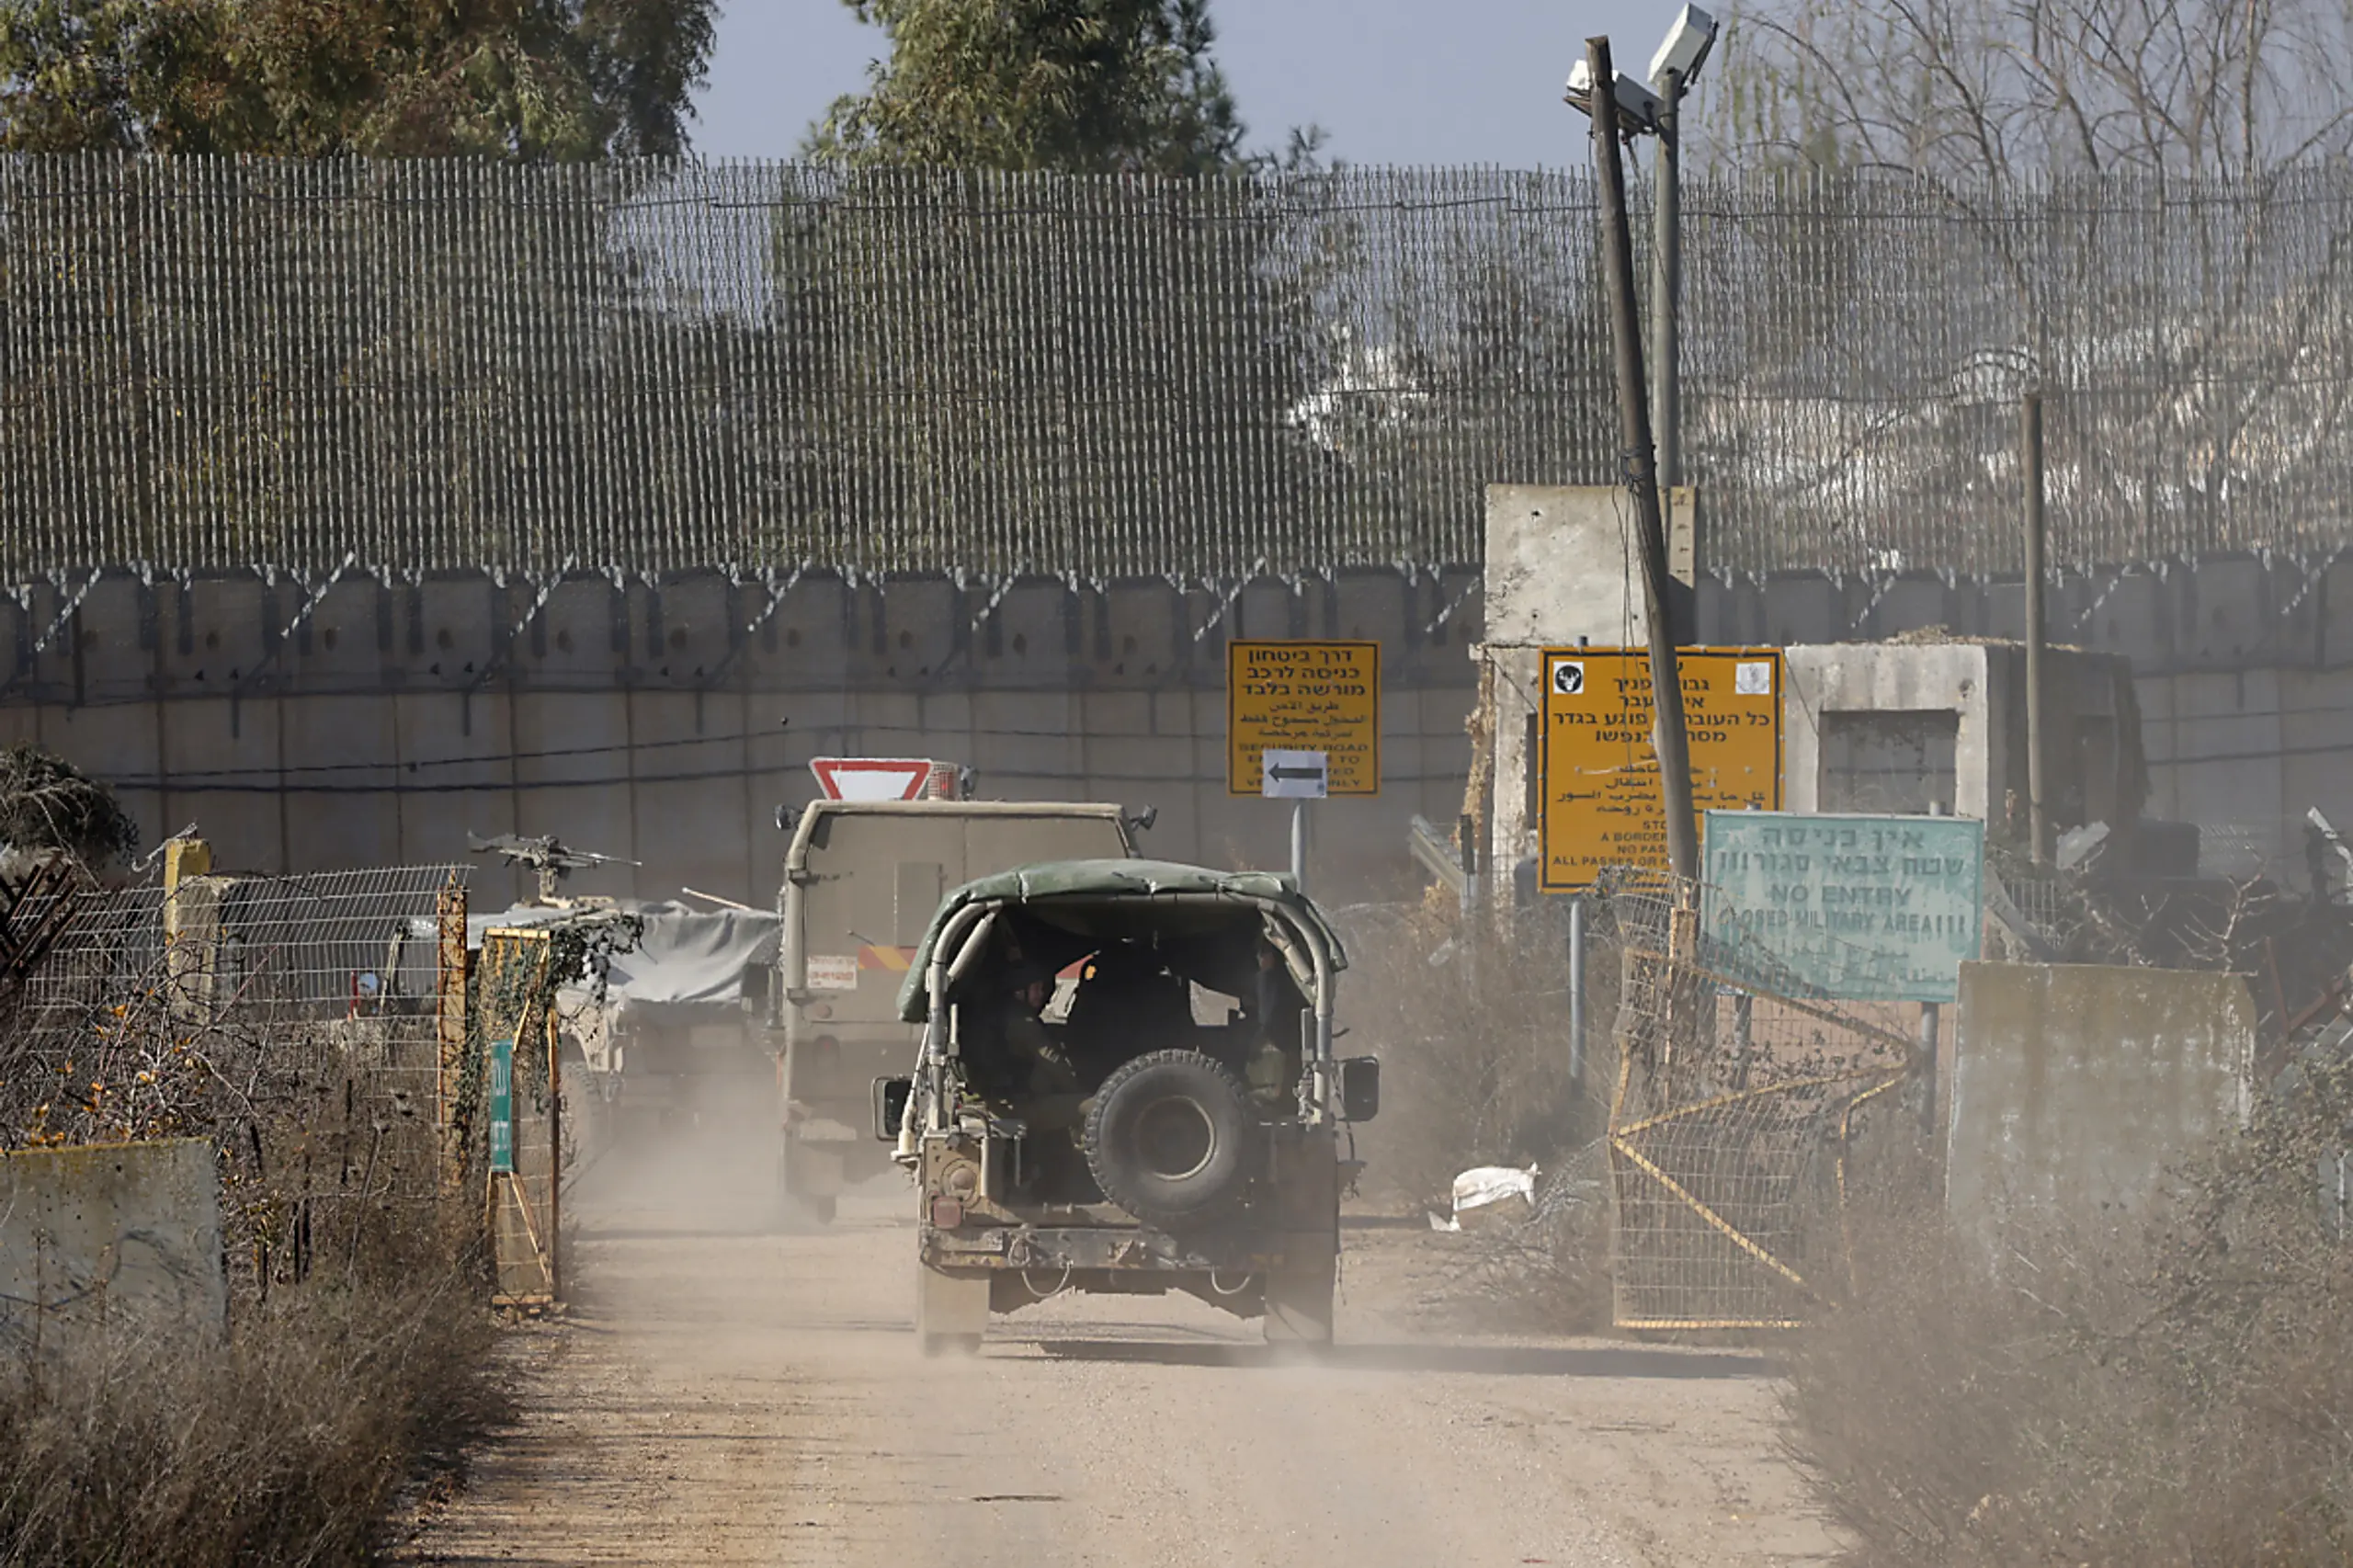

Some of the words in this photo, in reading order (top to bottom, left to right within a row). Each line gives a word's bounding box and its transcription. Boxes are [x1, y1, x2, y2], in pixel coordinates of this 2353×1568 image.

[1248, 649, 1310, 664] ביטחון
[1318, 649, 1352, 665] דרך
[1246, 665, 1294, 679] לרכב
[1302, 666, 1360, 679] כניסה
[1243, 681, 1290, 696] בלבד
[1297, 683, 1366, 696] מורשה
[1613, 677, 1653, 692] פניך
[1682, 678, 1710, 690] גבו
[1618, 696, 1654, 708] עבר
[1685, 696, 1705, 709] אי
[1552, 711, 1597, 725] בגדר
[1603, 712, 1648, 726] פוגע
[1745, 710, 1770, 726] כל
[1323, 743, 1368, 752] ROAD
[1339, 755, 1360, 765] TO
[1643, 820, 1667, 830] STO
[1600, 832, 1609, 842] A
[1762, 827, 1857, 847] כניסה
[1870, 828, 1924, 851] אין
[1617, 844, 1637, 855] NO
[1552, 856, 1578, 866] ALL
[1824, 853, 1892, 875] צבאי
[1902, 856, 1965, 876] שטח
[1770, 883, 1810, 903] NO
[1821, 885, 1913, 906] ENTRY
[1717, 906, 1789, 927] COSED
[1794, 910, 1875, 930] MILITARY
